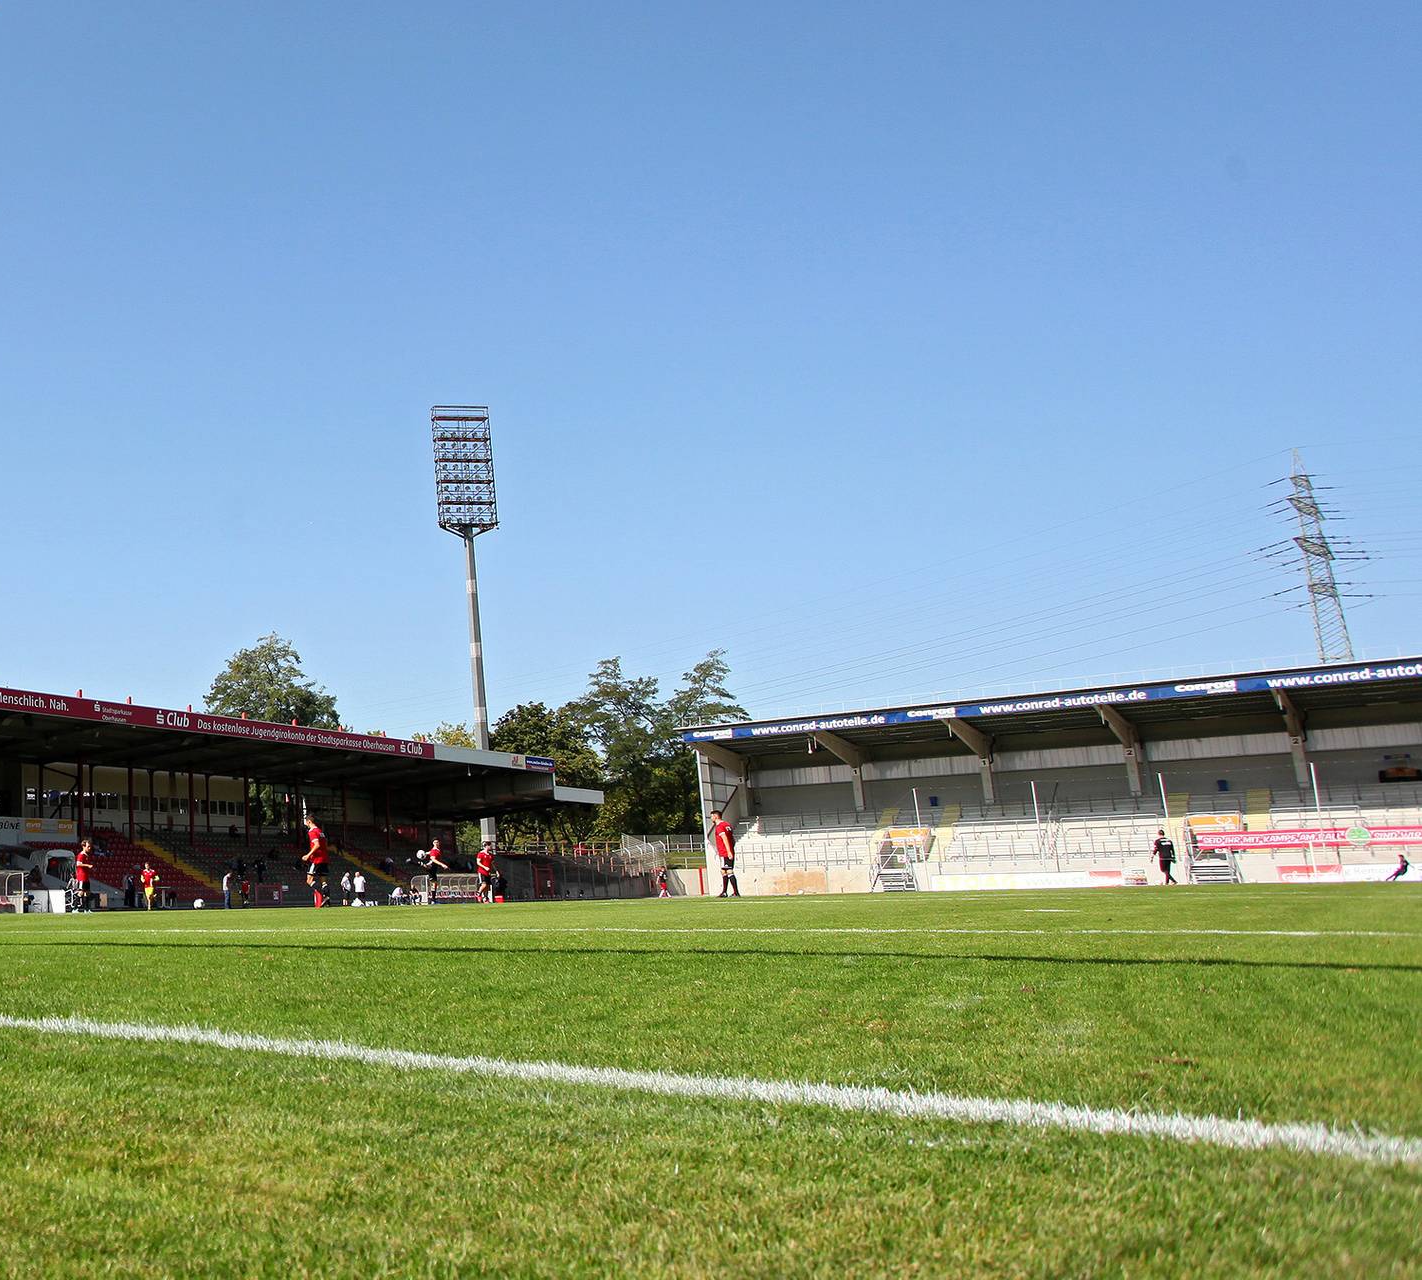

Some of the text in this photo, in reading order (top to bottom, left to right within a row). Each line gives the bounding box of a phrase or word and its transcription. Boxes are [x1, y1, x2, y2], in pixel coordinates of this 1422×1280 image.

[49, 698, 69, 712] Nah.
[979, 690, 1147, 714] www.conrad-autoteile.de
[166, 712, 190, 728] Club
[751, 714, 885, 735] www.conrad-autoteile.de
[197, 718, 212, 730] Das
[213, 722, 250, 735] kostenlose
[251, 726, 305, 742] Jugendgirokonto
[306, 733, 317, 743] der
[317, 734, 362, 748] Stadtsparkasse
[362, 739, 396, 751] Oberhausen
[407, 742, 423, 755] Club
